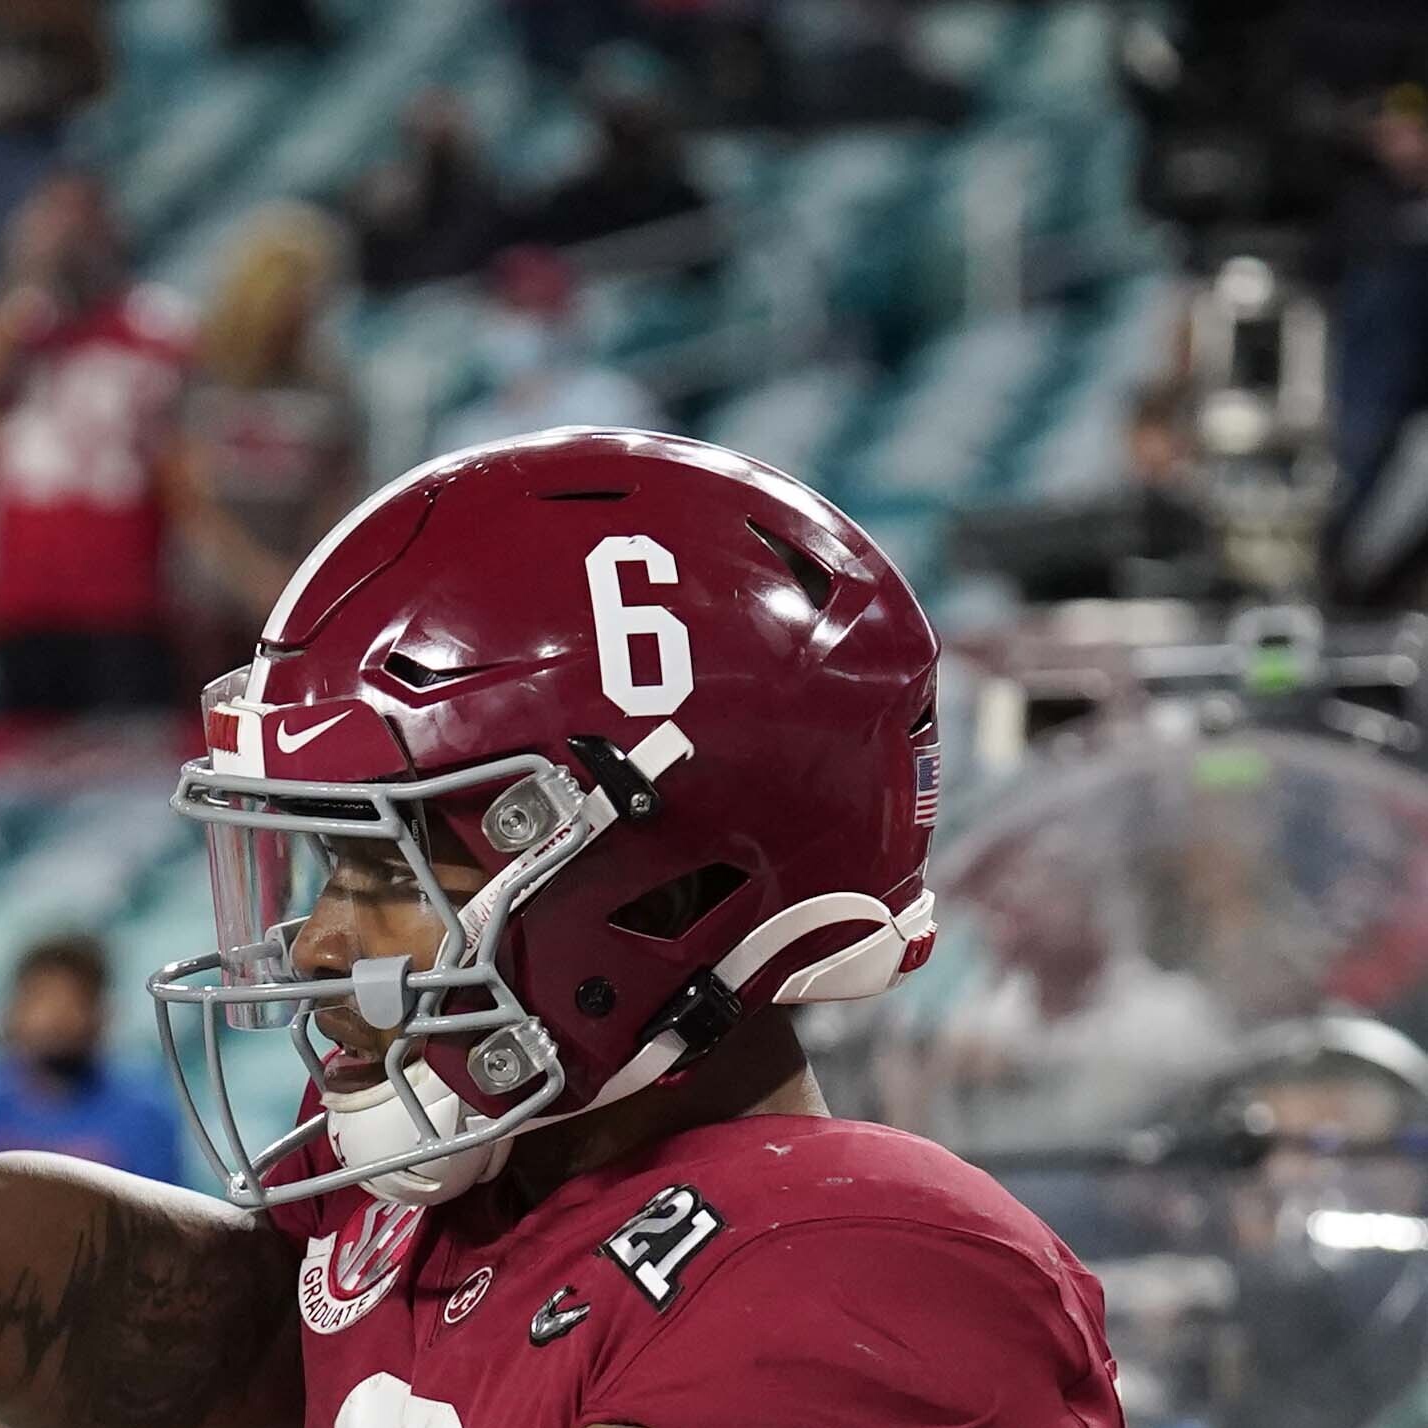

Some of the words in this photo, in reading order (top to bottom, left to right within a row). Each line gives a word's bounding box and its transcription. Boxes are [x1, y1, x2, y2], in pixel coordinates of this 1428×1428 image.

[585, 536, 694, 717] 6
[337, 1200, 427, 1291] SEC
[303, 1265, 371, 1330] GRADUATE
